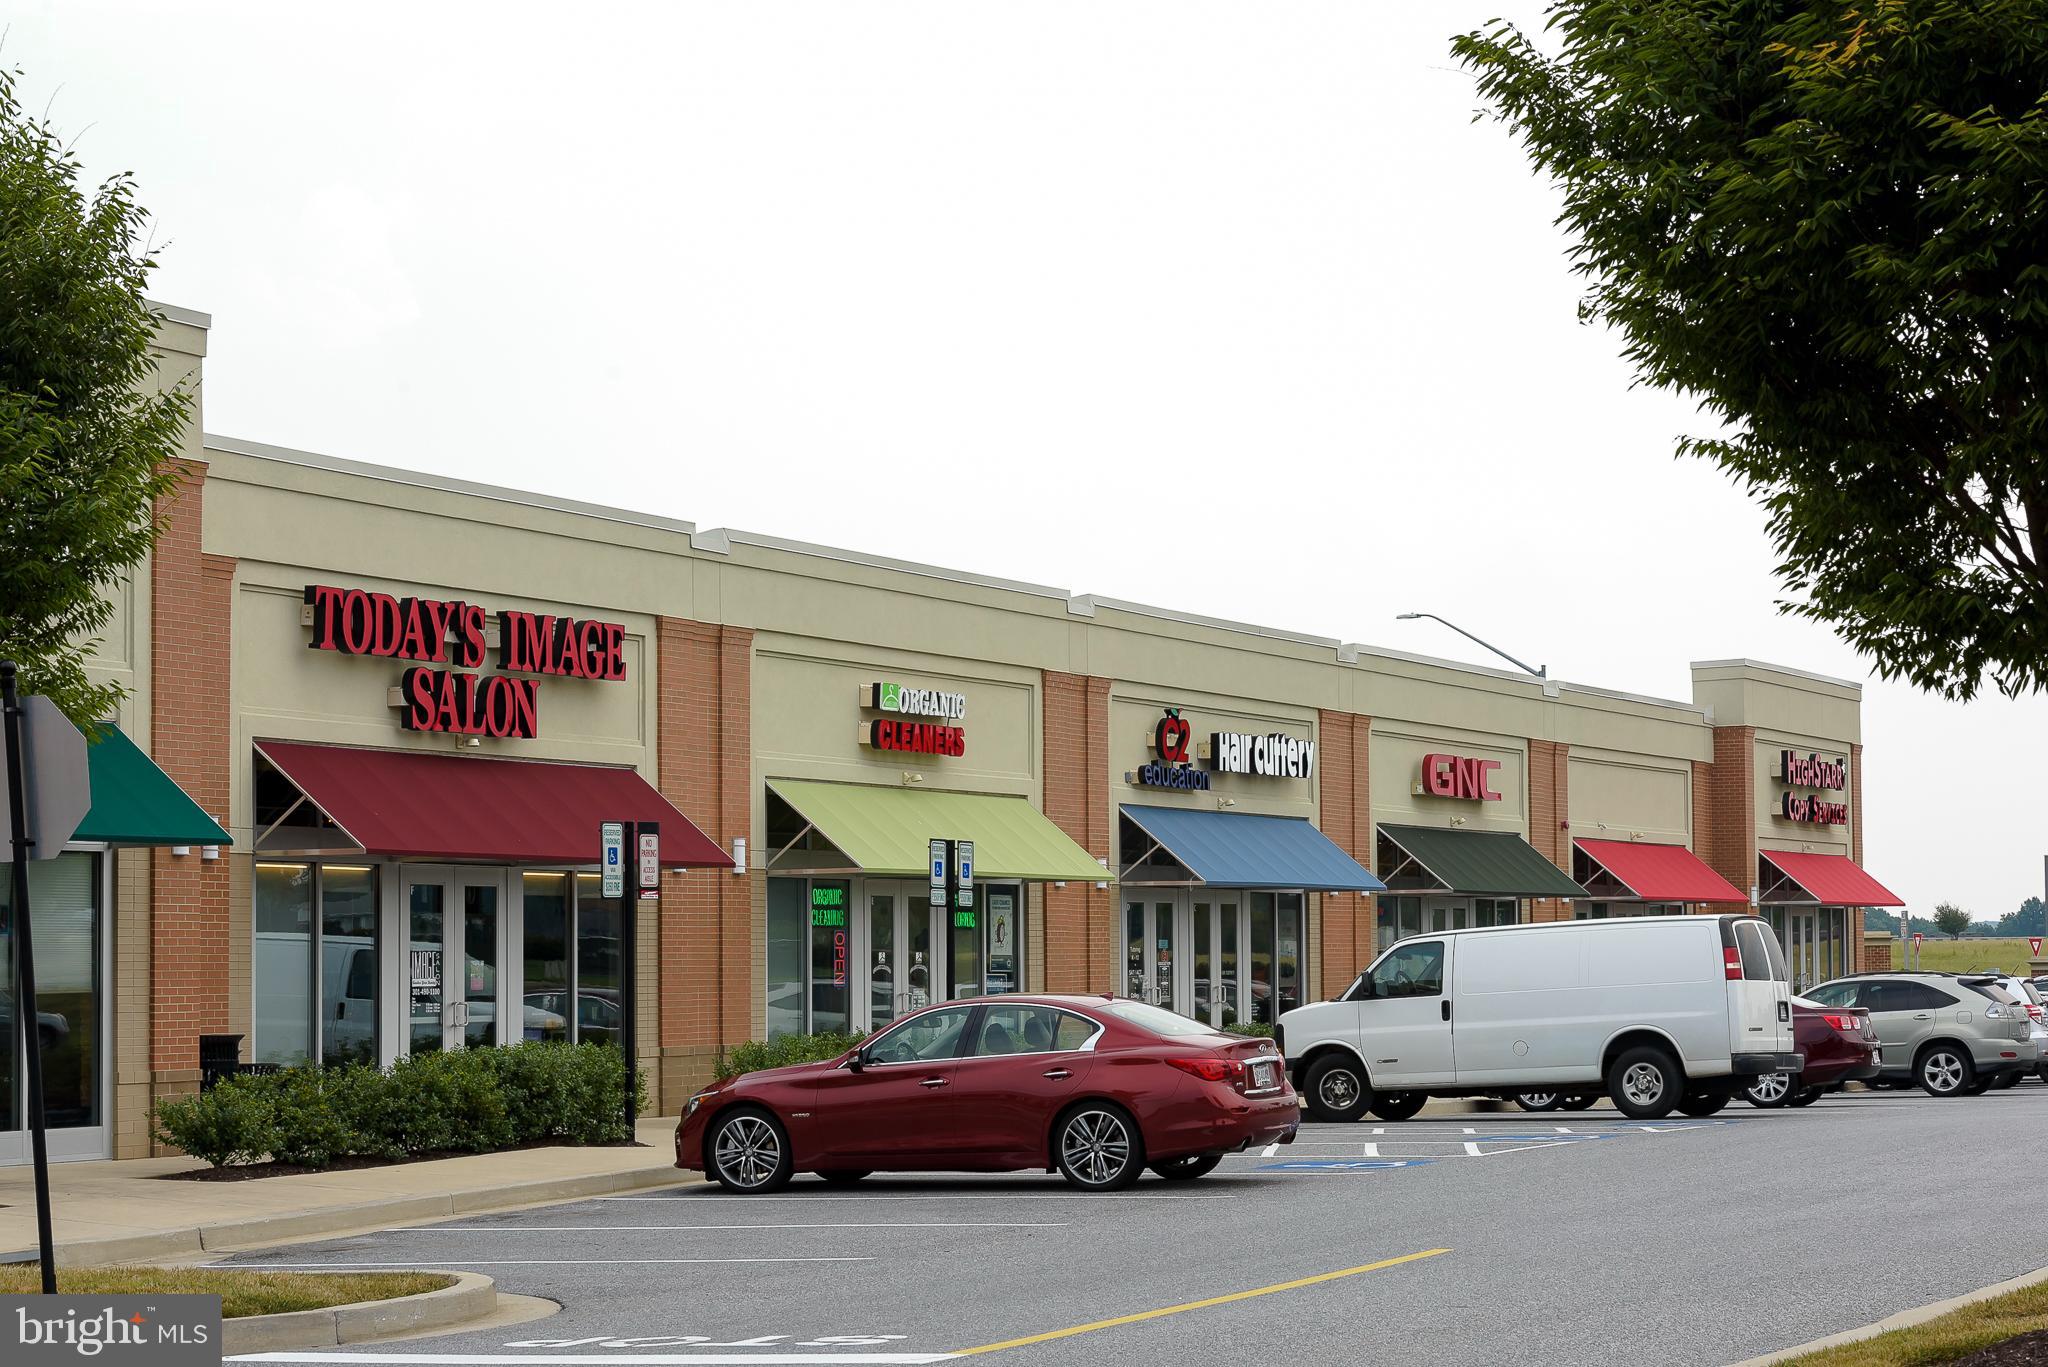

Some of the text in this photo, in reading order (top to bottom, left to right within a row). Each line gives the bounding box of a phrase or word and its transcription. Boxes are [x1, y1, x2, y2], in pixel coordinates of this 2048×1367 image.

[312, 584, 626, 681] TODAY'S IMAGE
[409, 666, 541, 738] SALON
[899, 686, 966, 719] ORGANIC
[877, 719, 965, 757] CLEANERS
[1218, 732, 1252, 774] Hair
[1144, 763, 1212, 790] education
[1428, 754, 1502, 801] GNC
[641, 849, 657, 858] PARKING
[645, 839, 653, 848] NO
[813, 888, 843, 905] ORGANIC
[811, 909, 845, 926] CLEANING
[411, 951, 437, 980] IMAGE
[834, 932, 845, 985] OPEN
